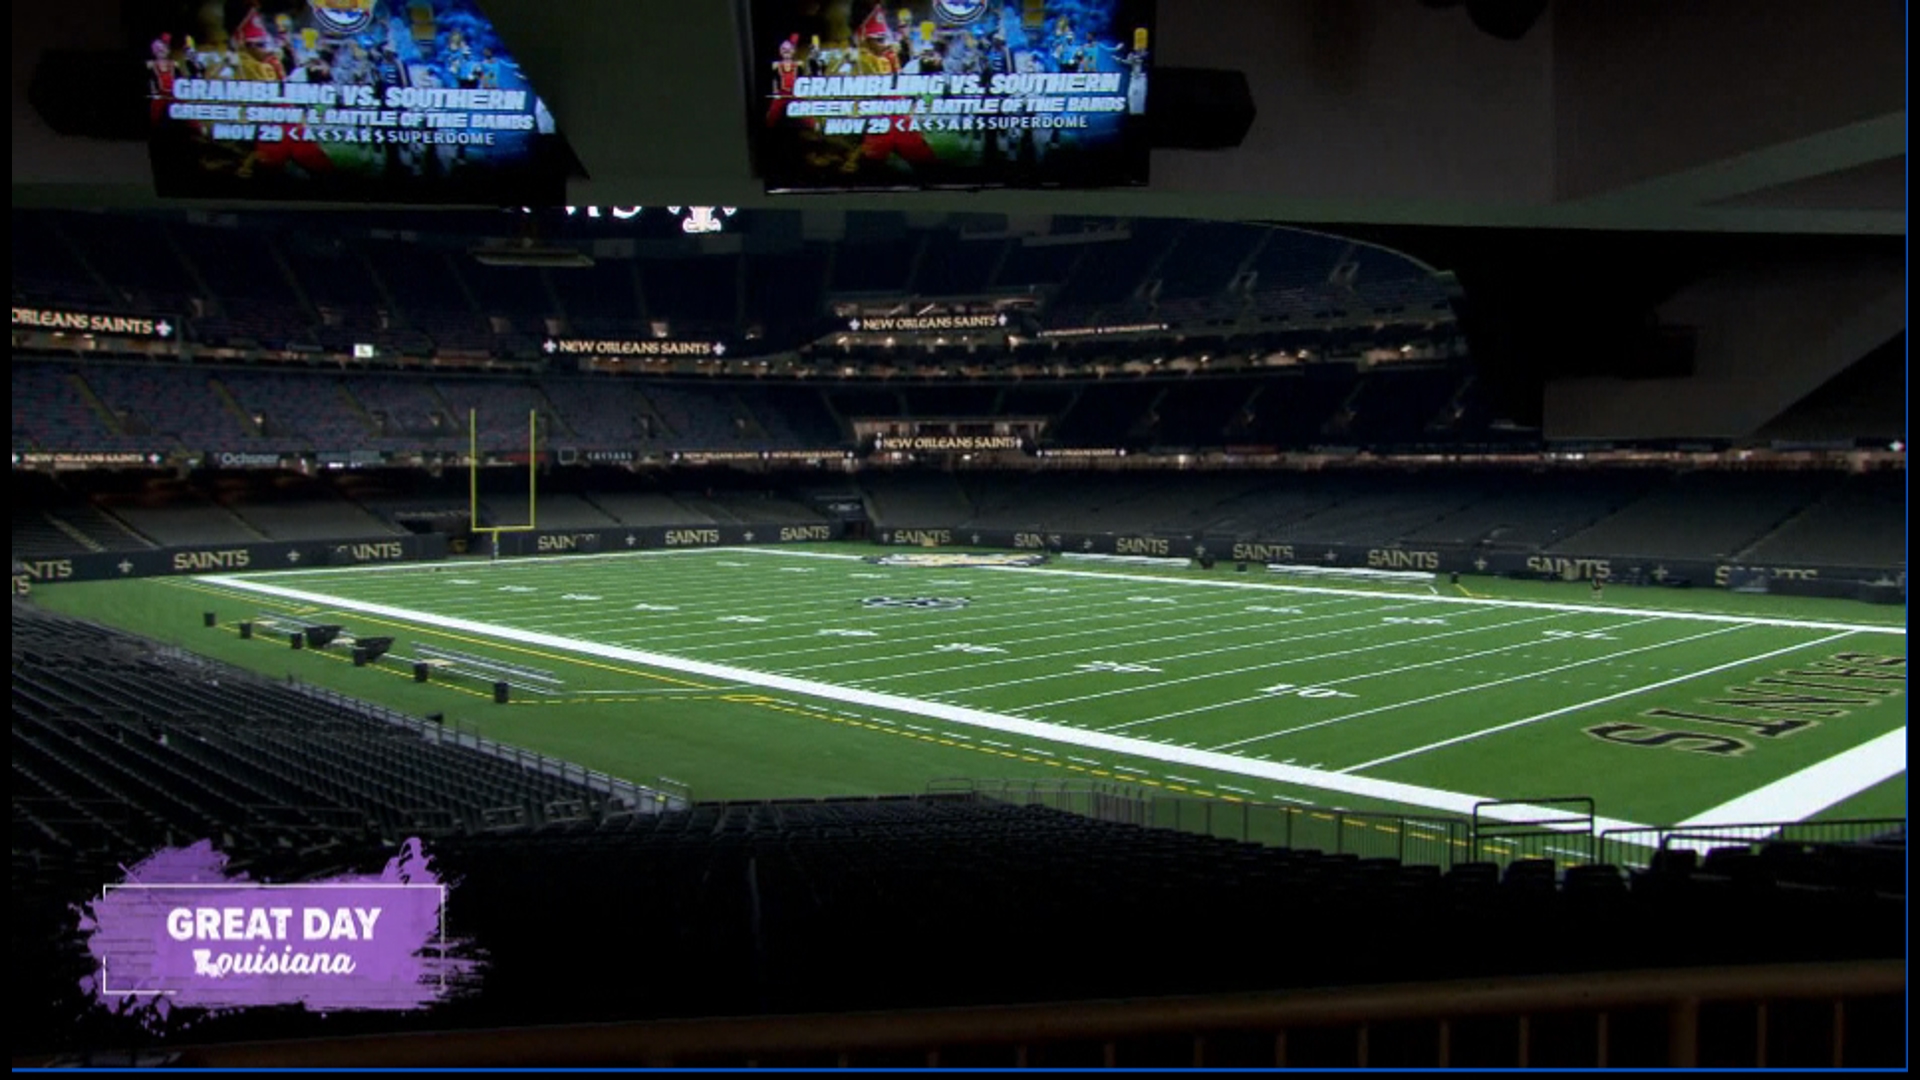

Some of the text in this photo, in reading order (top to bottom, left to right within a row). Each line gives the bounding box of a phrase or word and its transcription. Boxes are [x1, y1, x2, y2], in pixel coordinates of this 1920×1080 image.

[172, 78, 526, 110] GRAMBLING VS. SOUTHERN
[793, 73, 1121, 98] GRAMBLING VS. SOUTHERN
[1001, 97, 1025, 113] OF
[1026, 97, 1066, 113] THE
[400, 112, 424, 128] OF
[426, 112, 467, 129] THE
[824, 118, 864, 136] NOV
[867, 118, 892, 134] 29
[988, 115, 1089, 130] SUPERDOME
[213, 124, 255, 141] NOV
[258, 124, 283, 141] 29
[387, 131, 495, 146] SUPERDOME
[91, 315, 153, 335] SAINTS
[863, 315, 998, 330] NEW ORLEANS SAINTS
[559, 339, 711, 356] NEW ORLEANS SAINTS
[883, 436, 912, 449] NEW
[914, 436, 973, 449] ORLEANS
[664, 529, 720, 545] SAINTS
[780, 525, 830, 541] SAINTS
[1116, 536, 1169, 556] SAINTS
[1232, 542, 1294, 561] SAINTS
[173, 548, 250, 571] SAINTS
[1367, 549, 1440, 569] SAINTS
